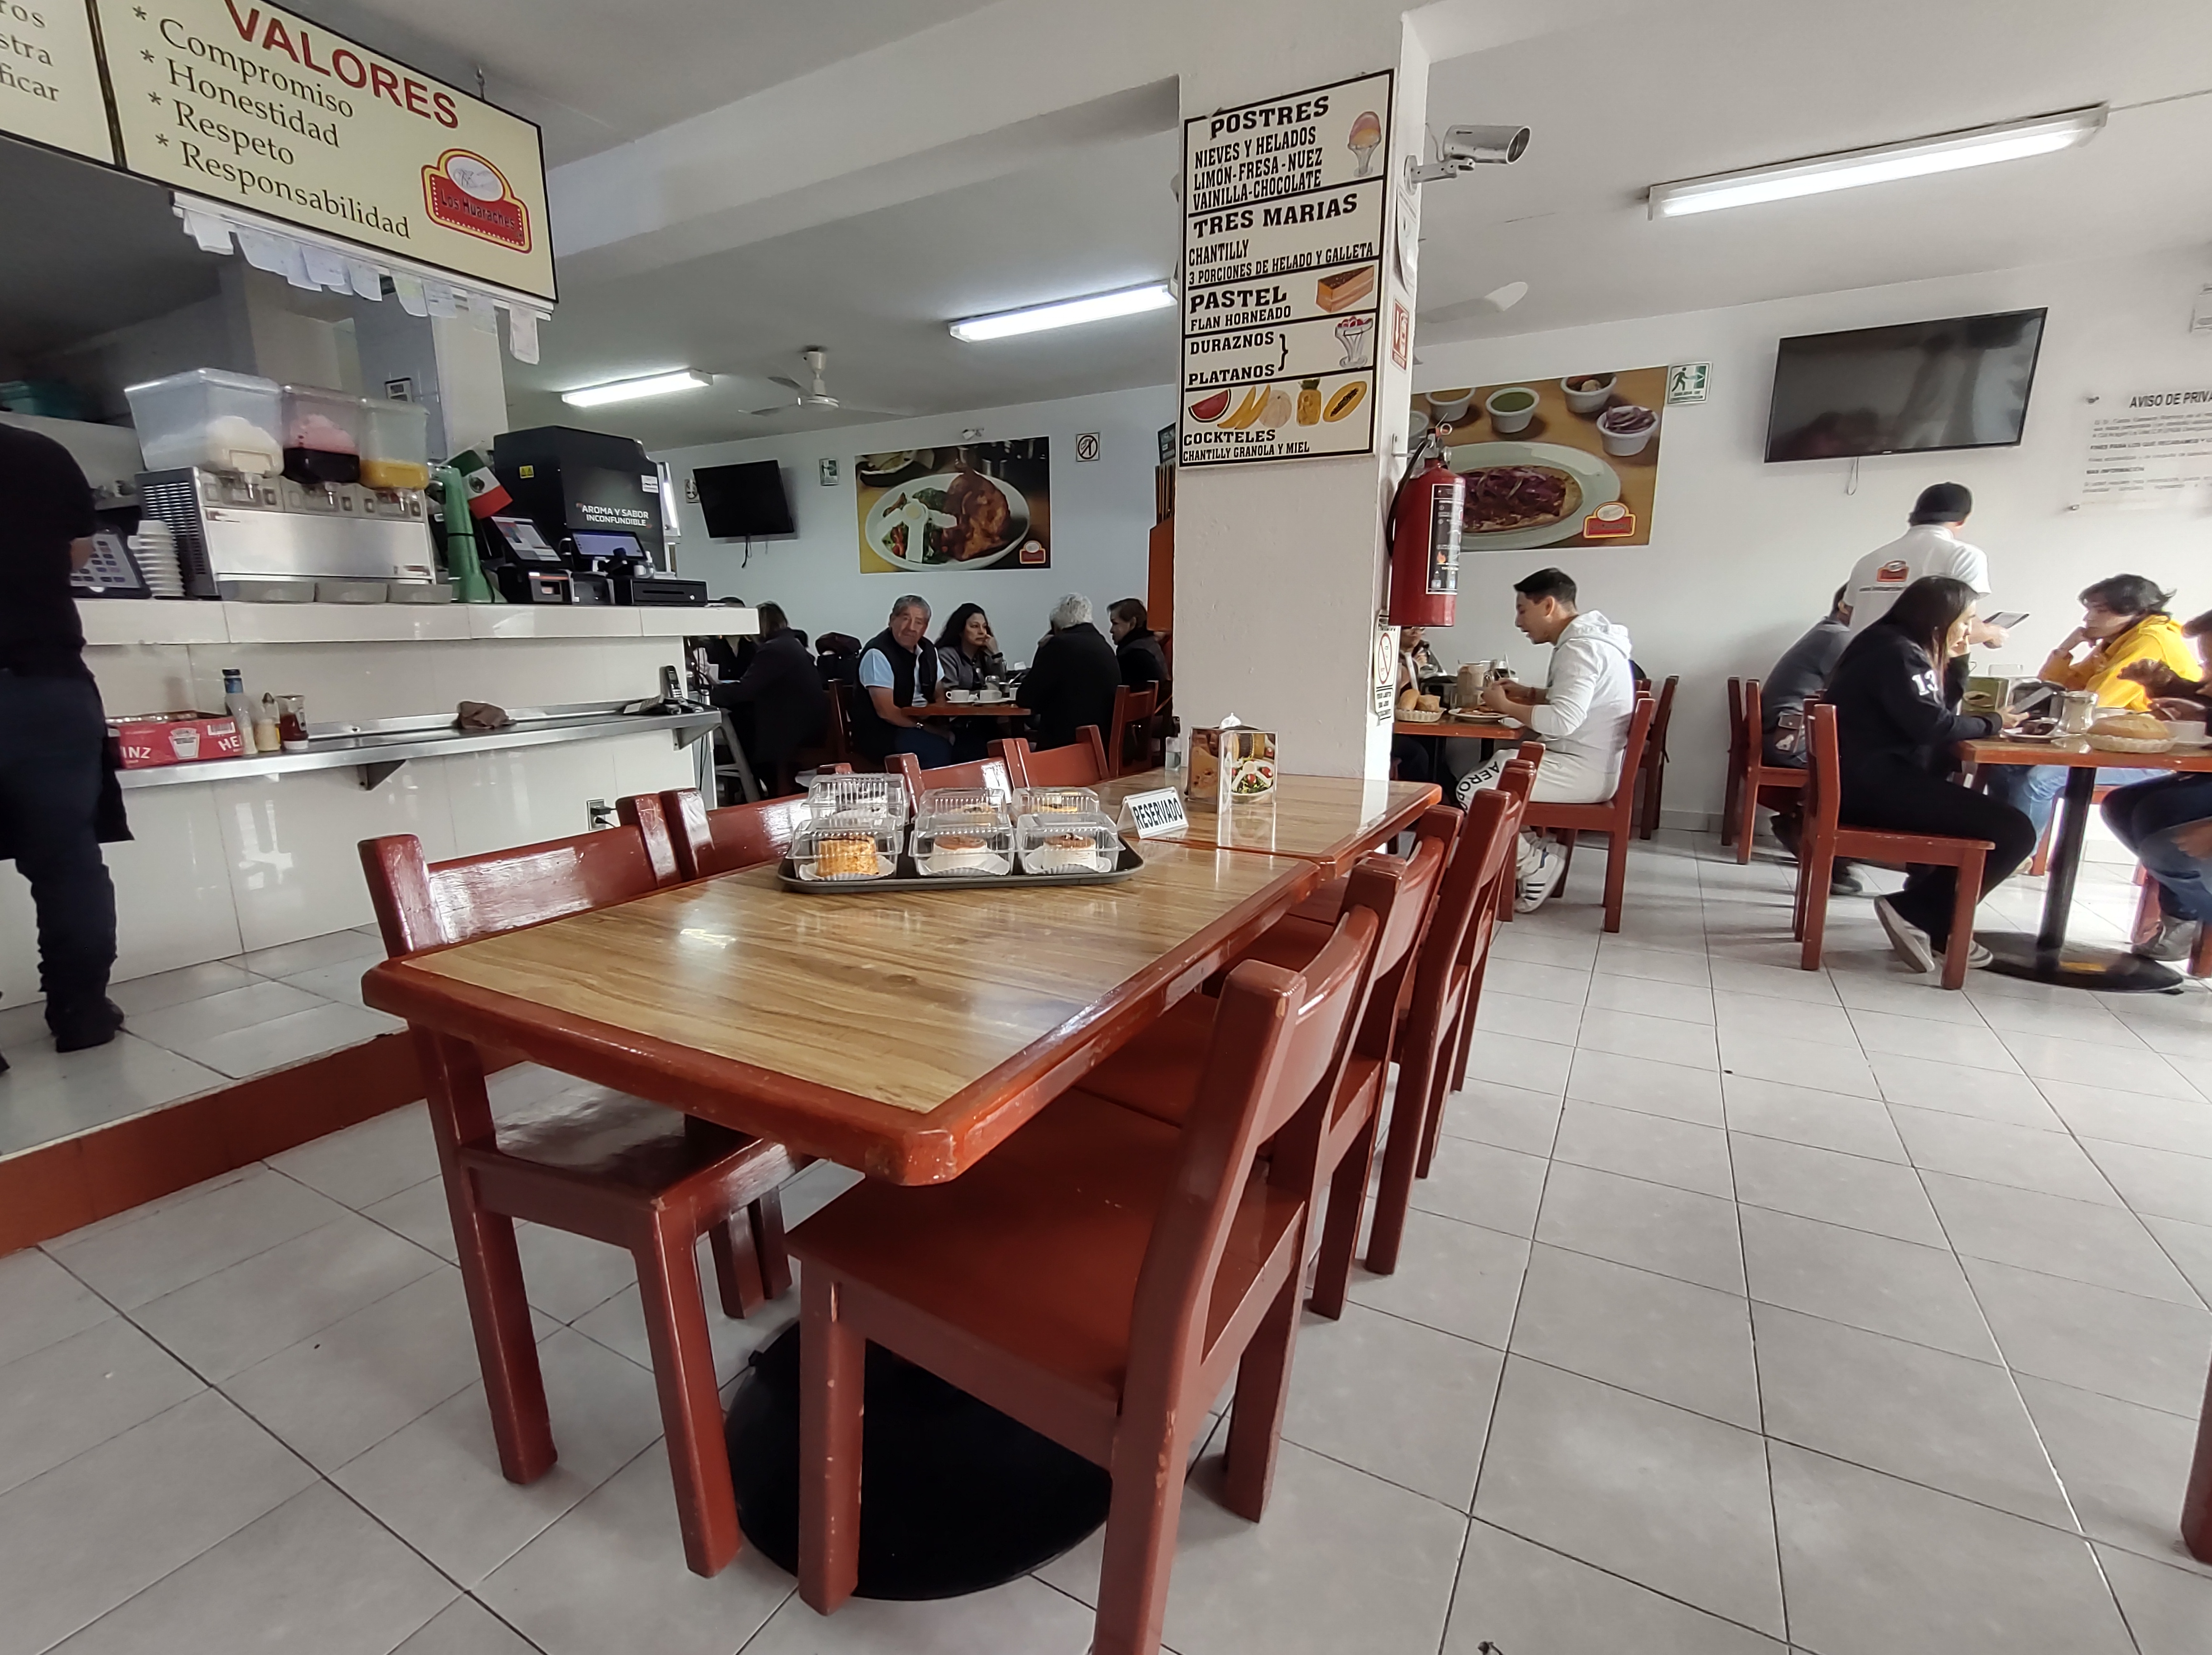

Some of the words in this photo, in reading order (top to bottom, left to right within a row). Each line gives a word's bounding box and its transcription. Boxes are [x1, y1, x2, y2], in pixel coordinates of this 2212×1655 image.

[160, 19, 353, 117] Compromiso
[224, 0, 458, 128] VALORES
[165, 57, 340, 148] Honestidad
[1210, 95, 1329, 139] POSTRES
[172, 99, 294, 165] Respeto
[1195, 143, 1239, 169] NIEVES
[1244, 139, 1252, 158] Y
[1256, 126, 1316, 155] HELADOS
[180, 141, 411, 239] Responsabilidad
[440, 188, 460, 210] Los
[462, 197, 515, 230] Huaraches
[1193, 210, 1253, 238] TRES
[1263, 193, 1357, 227] MARIAS
[1189, 239, 1249, 266] CHANTILLY
[1189, 271, 1195, 285] 3
[1198, 263, 1251, 284] PORCIONES
[1255, 259, 1269, 274] DE
[1272, 252, 1312, 272] HELADO
[1316, 250, 1322, 265] Y
[1325, 242, 1373, 263] GALLETA
[1190, 286, 1287, 314] PASTEL
[1191, 316, 1221, 331] FLAN
[1225, 306, 1291, 327] HORNEADO
[1190, 331, 1274, 355] DURAZNOS
[1188, 364, 1275, 386] PLATANOS
[2129, 394, 2163, 408] AVISO
[2165, 393, 2182, 406] DE
[1183, 448, 1231, 461] CHANTILLY
[1234, 444, 1274, 458] GRANOLA
[1278, 443, 1283, 454] Y
[1286, 441, 1310, 454] MIEL
[1184, 429, 1276, 446] COCKTELES
[582, 505, 613, 515] AROMA
[622, 509, 649, 519] SABOR
[586, 514, 647, 526] INCONFUNDIBLE
[1912, 670, 1938, 695] 13
[1132, 797, 1183, 829] RESERVADO
